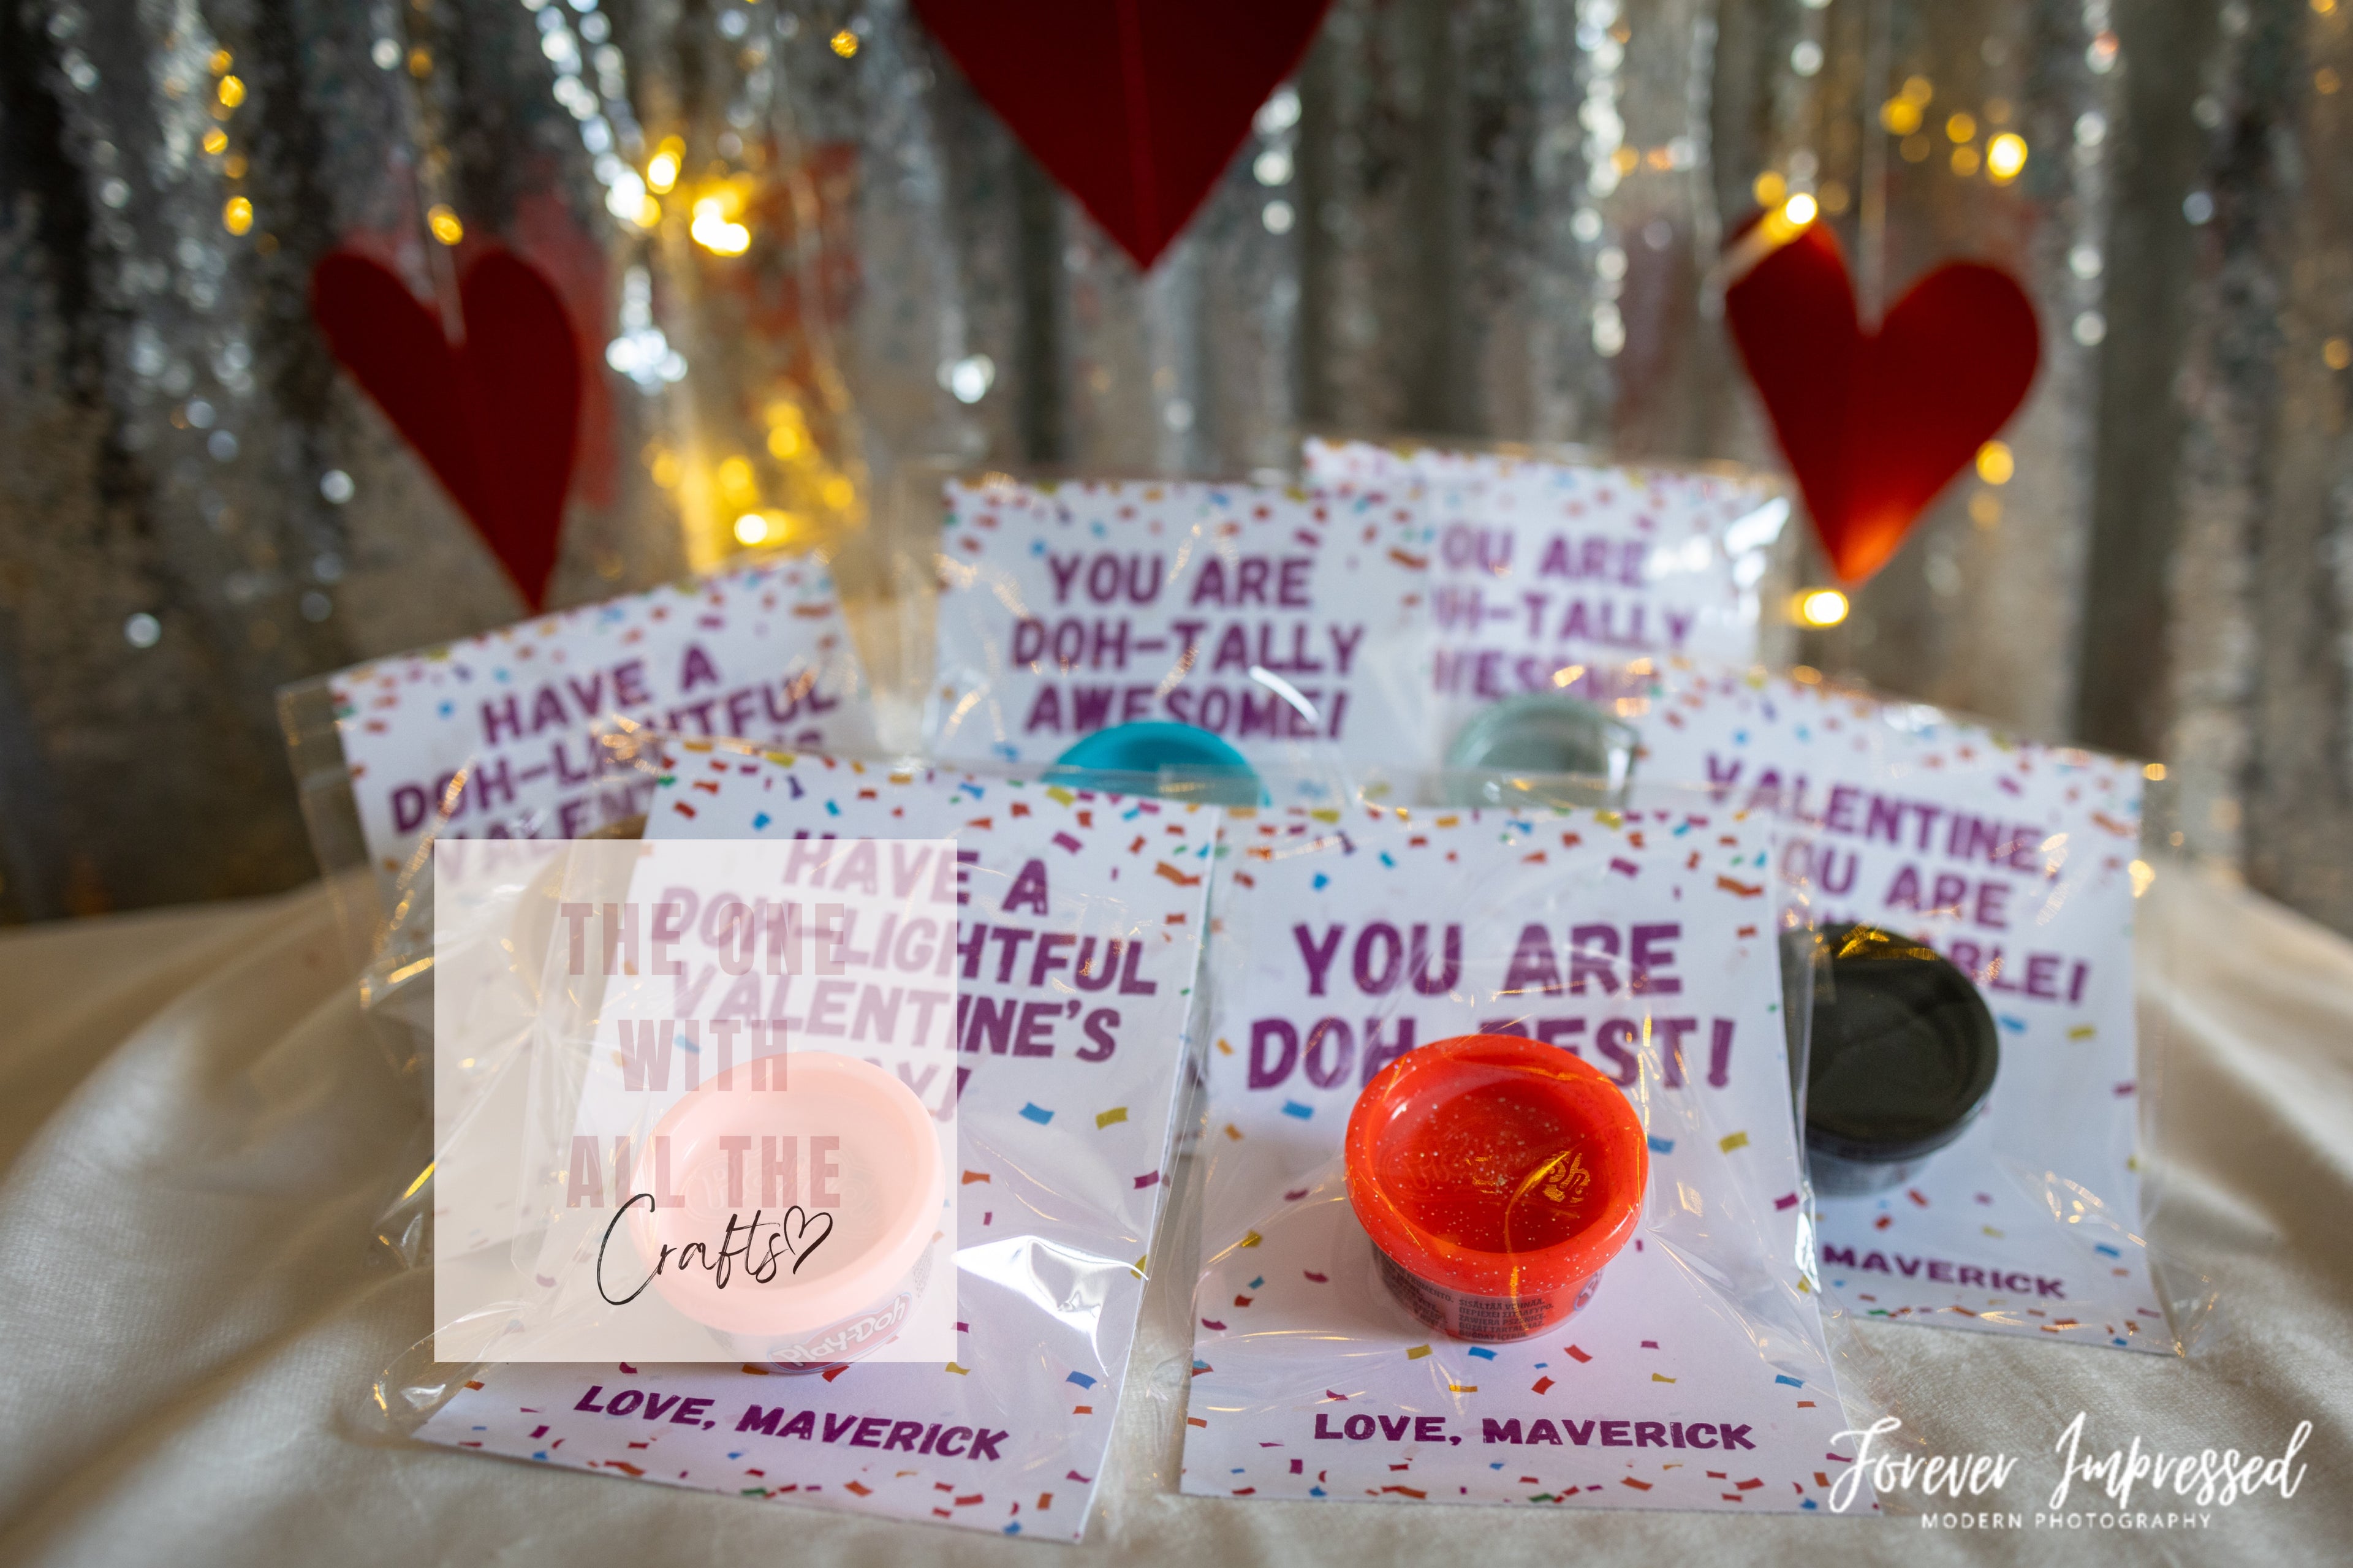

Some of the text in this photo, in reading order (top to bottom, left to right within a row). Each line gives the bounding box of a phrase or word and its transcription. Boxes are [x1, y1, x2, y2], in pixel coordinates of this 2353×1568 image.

[1047, 553, 1314, 608] YOU ARE
[1440, 521, 1514, 575] OU
[1010, 618, 1365, 673] DOH-TALLY
[480, 643, 720, 746] HAVE A
[1025, 684, 1348, 739] AWESOME!
[1705, 750, 2063, 881] VALENTINE,
[782, 830, 1050, 917] HAVE A
[1884, 862, 2013, 931] ARE
[651, 885, 1158, 996] DOH-LIGHTFUL
[1292, 922, 1683, 997] YOU ARE
[671, 960, 1121, 1063] VALENTINE'S
[1248, 1015, 1416, 1090] DOH
[1821, 1242, 2066, 1300] MAVERICK
[574, 1385, 1010, 1463] LOVE, MAVERICK
[1314, 1414, 1757, 1451] LOVE, MAVERICK
